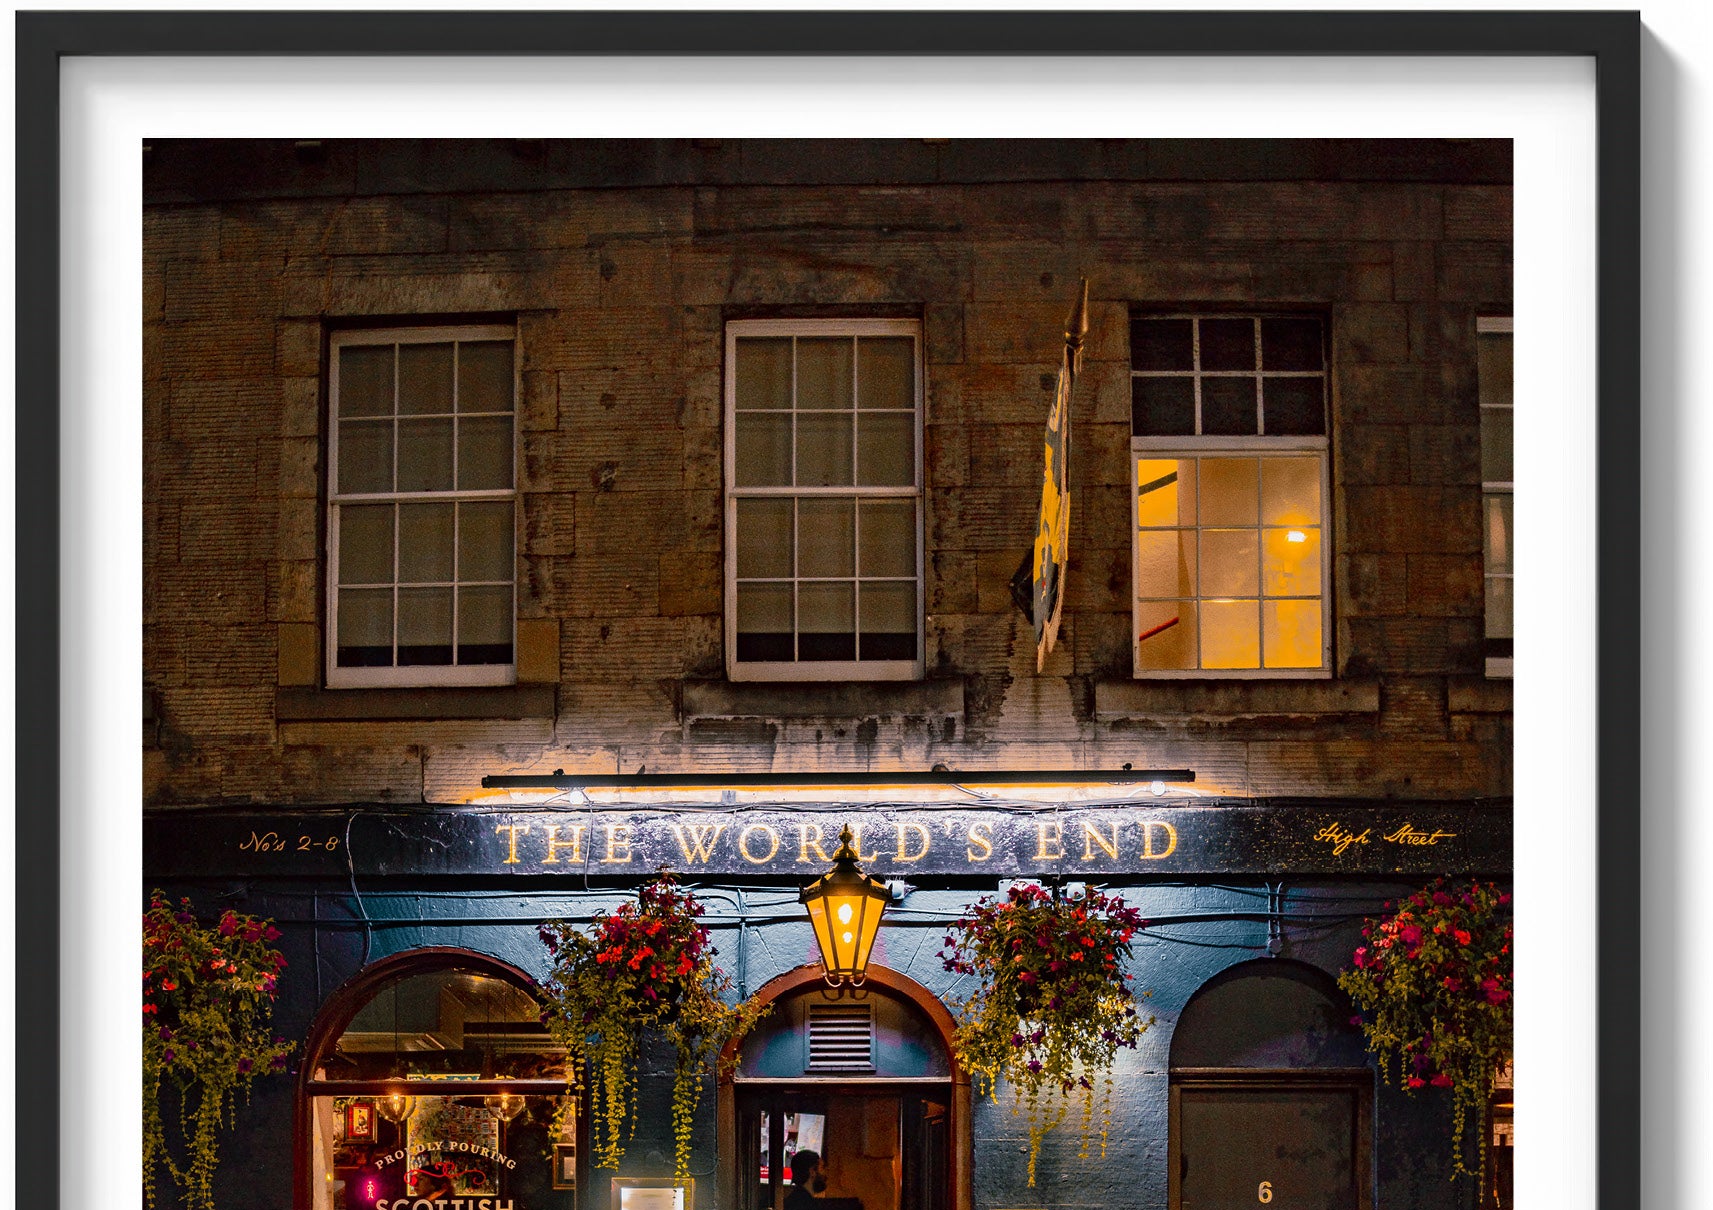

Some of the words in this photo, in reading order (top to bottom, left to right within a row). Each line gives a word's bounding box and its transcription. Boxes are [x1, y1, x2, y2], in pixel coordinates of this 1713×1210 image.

[495, 823, 632, 865] THE
[671, 819, 994, 865] WORLD'S
[1032, 820, 1178, 861] END
[1313, 821, 1371, 856] High
[1383, 823, 1457, 845] Street
[450, 1141, 517, 1170] POURING
[1258, 1181, 1273, 1204] 6
